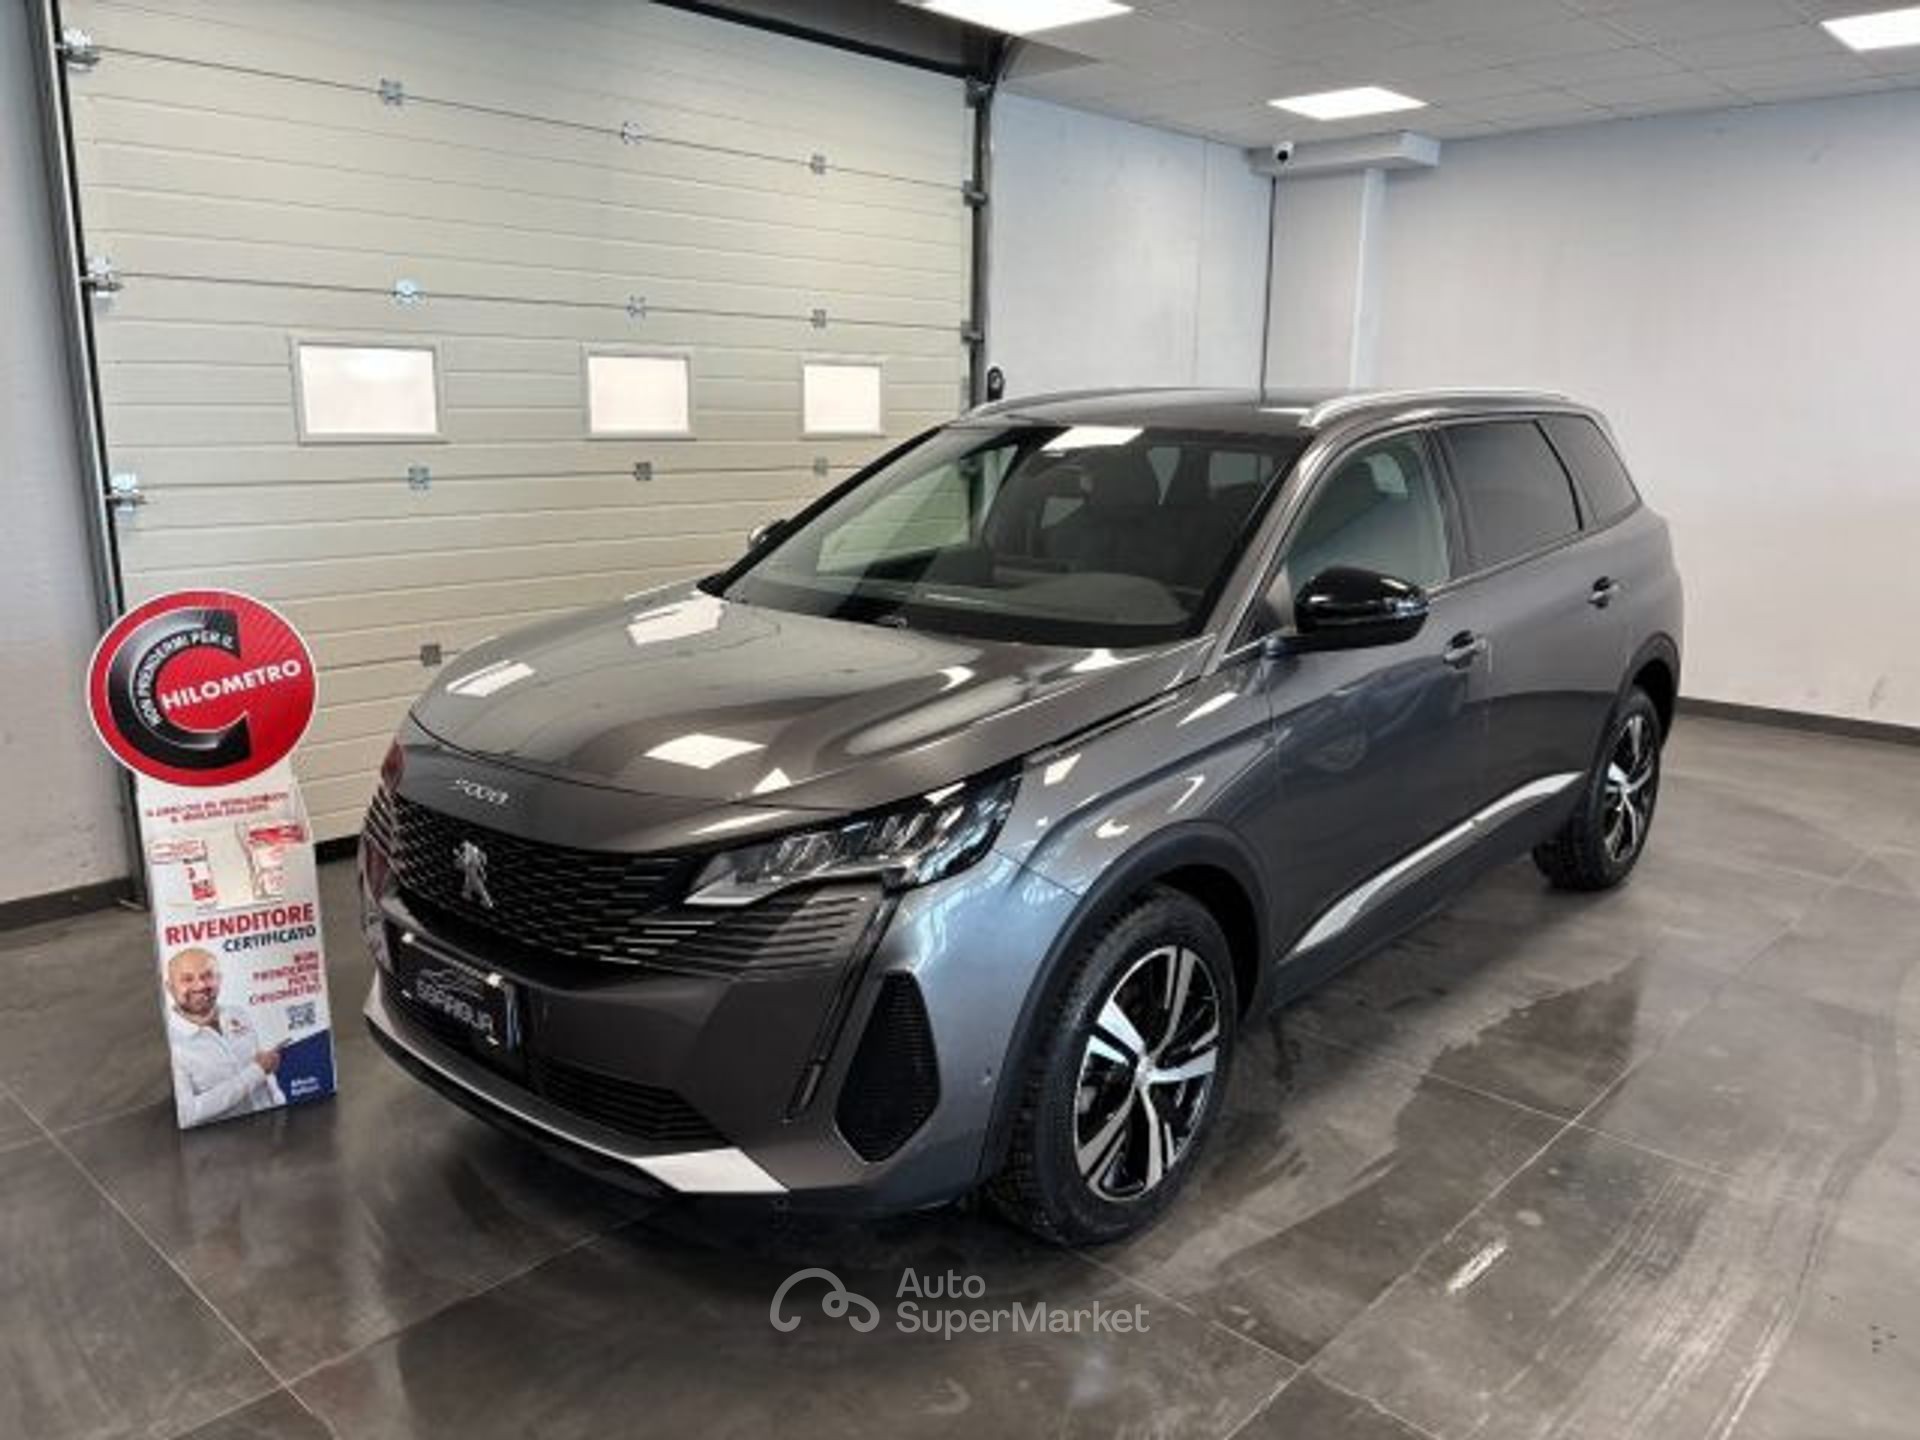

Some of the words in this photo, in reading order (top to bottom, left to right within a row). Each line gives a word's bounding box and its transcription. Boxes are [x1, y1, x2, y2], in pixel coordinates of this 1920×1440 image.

[191, 630, 221, 645] PER
[165, 903, 315, 946] RIVENDITORE
[222, 925, 317, 953] CERTIFICATO
